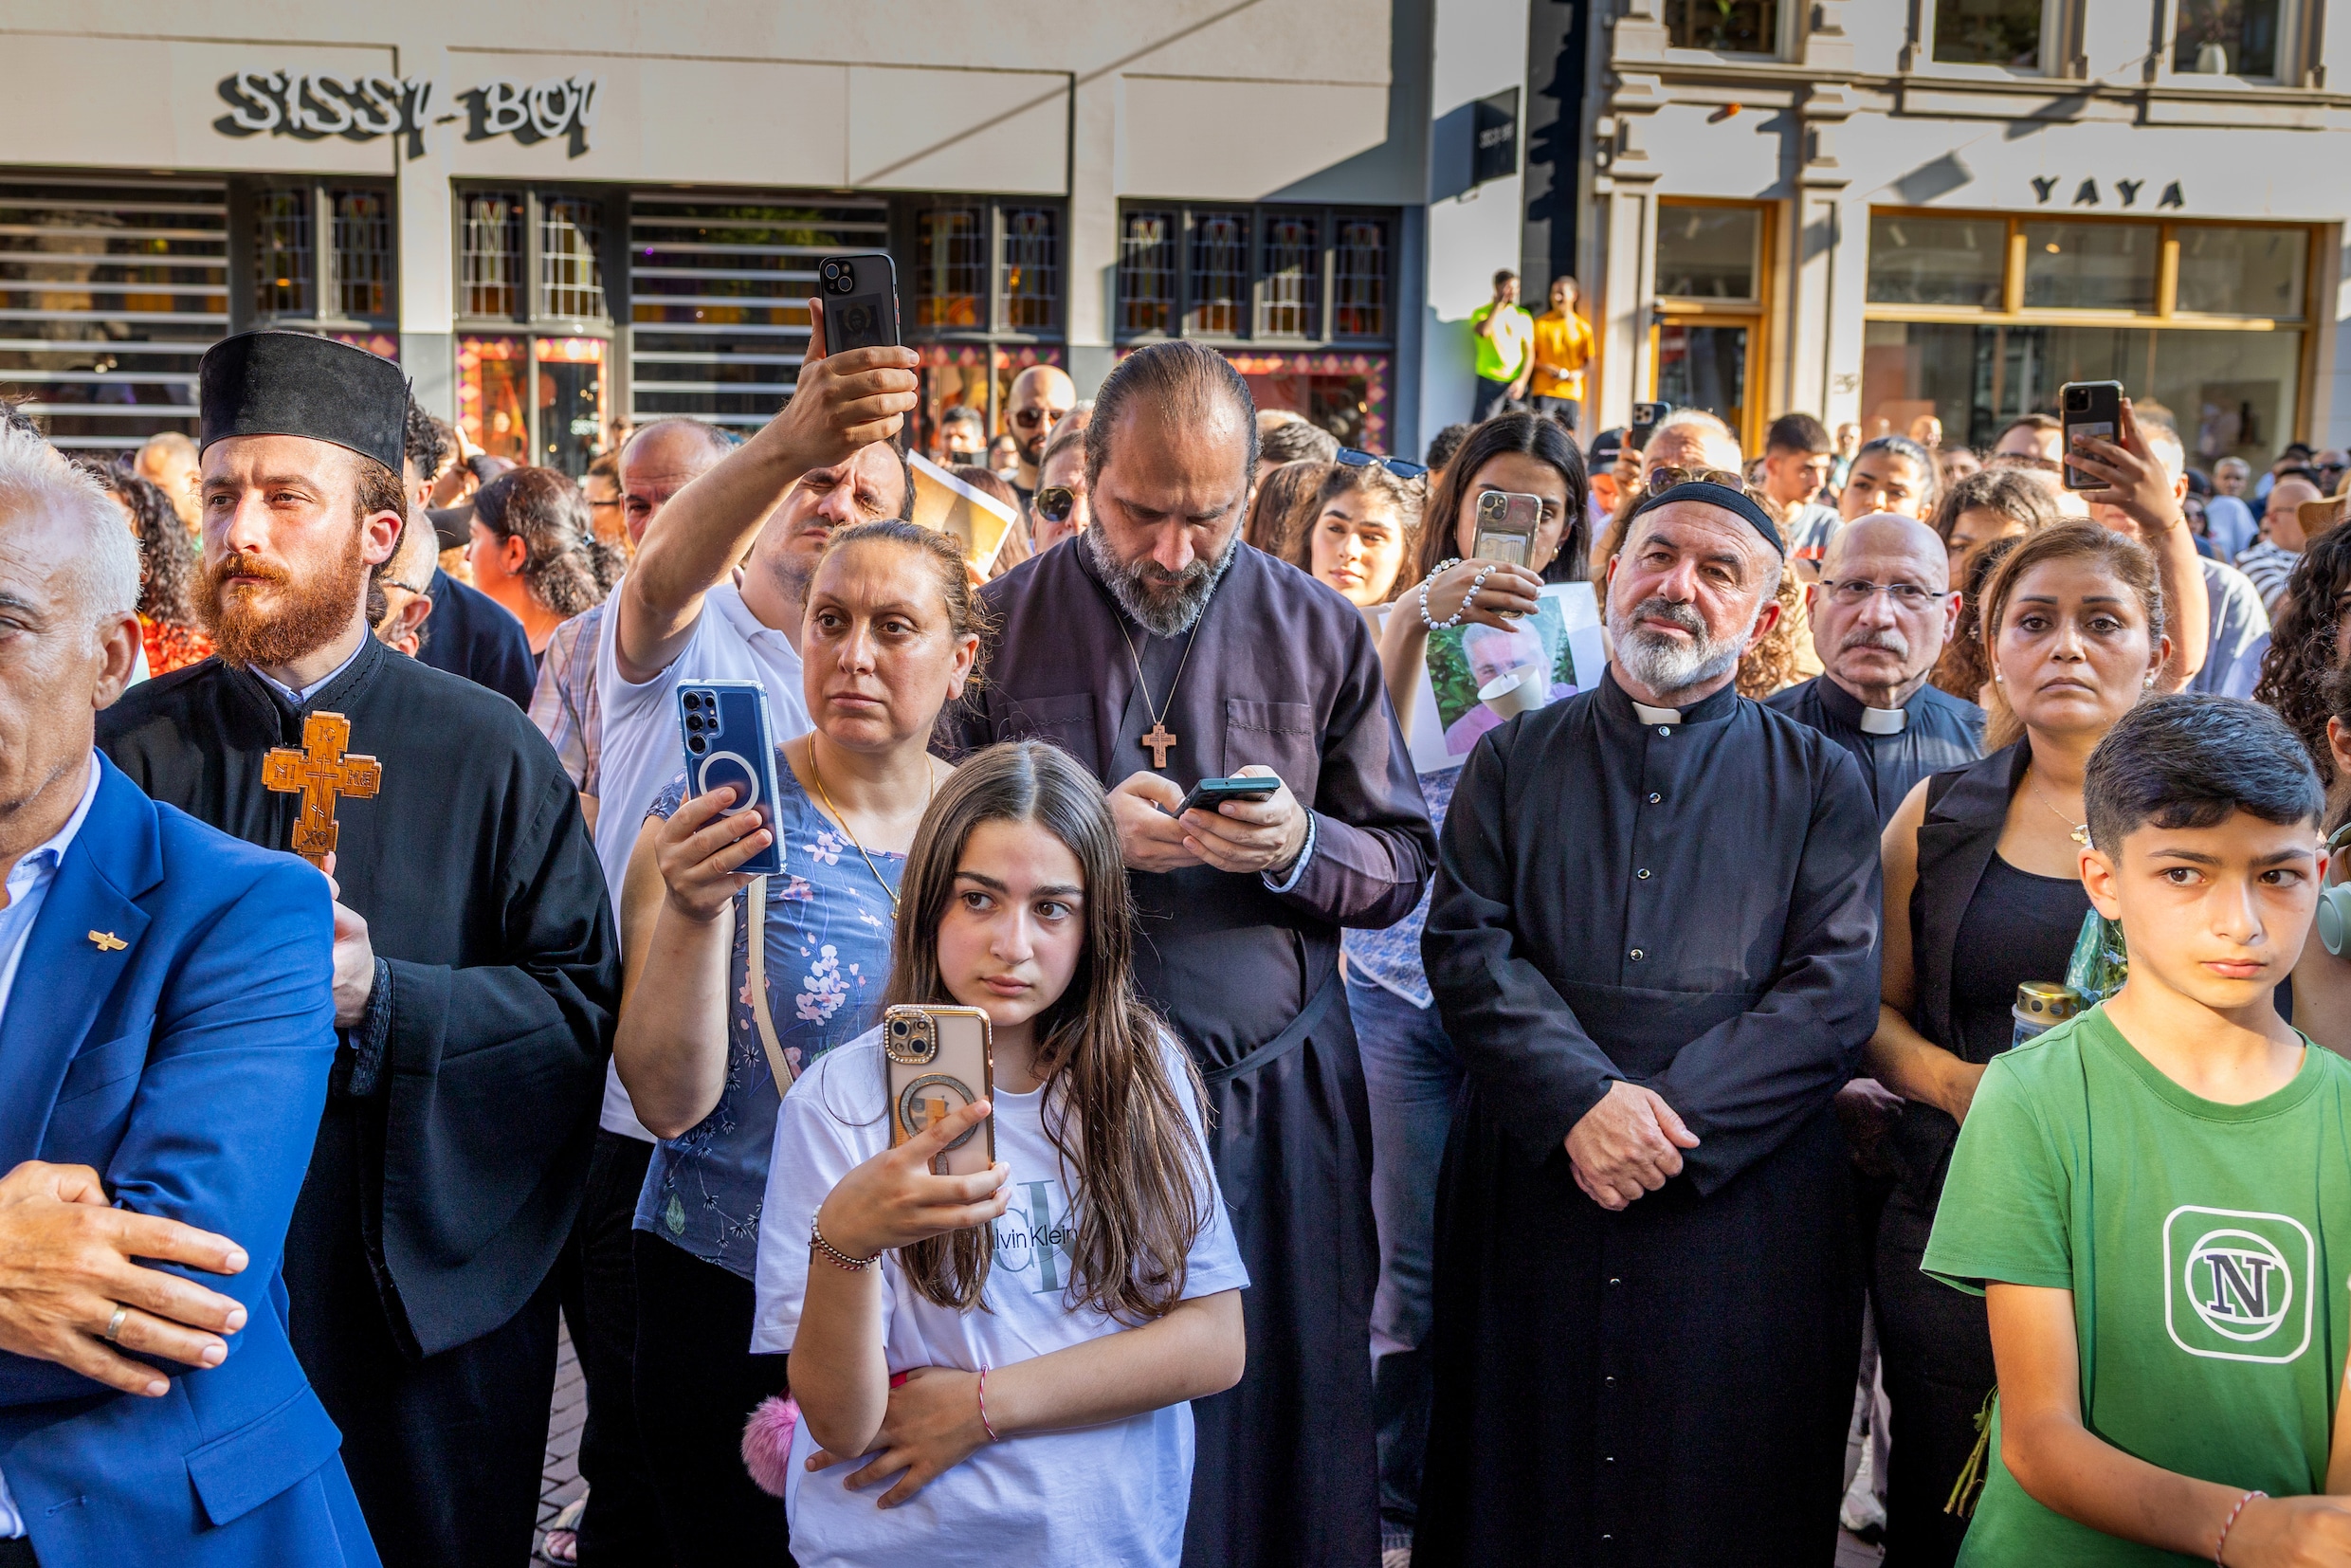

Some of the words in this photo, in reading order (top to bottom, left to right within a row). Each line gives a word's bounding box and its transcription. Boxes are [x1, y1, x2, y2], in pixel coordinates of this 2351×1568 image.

[212, 66, 608, 161] SISSY-BOY
[2030, 175, 2186, 210] YAYA
[993, 1228, 1028, 1250] lvin
[1030, 1224, 1079, 1248] Klein
[2204, 1253, 2275, 1319] N
